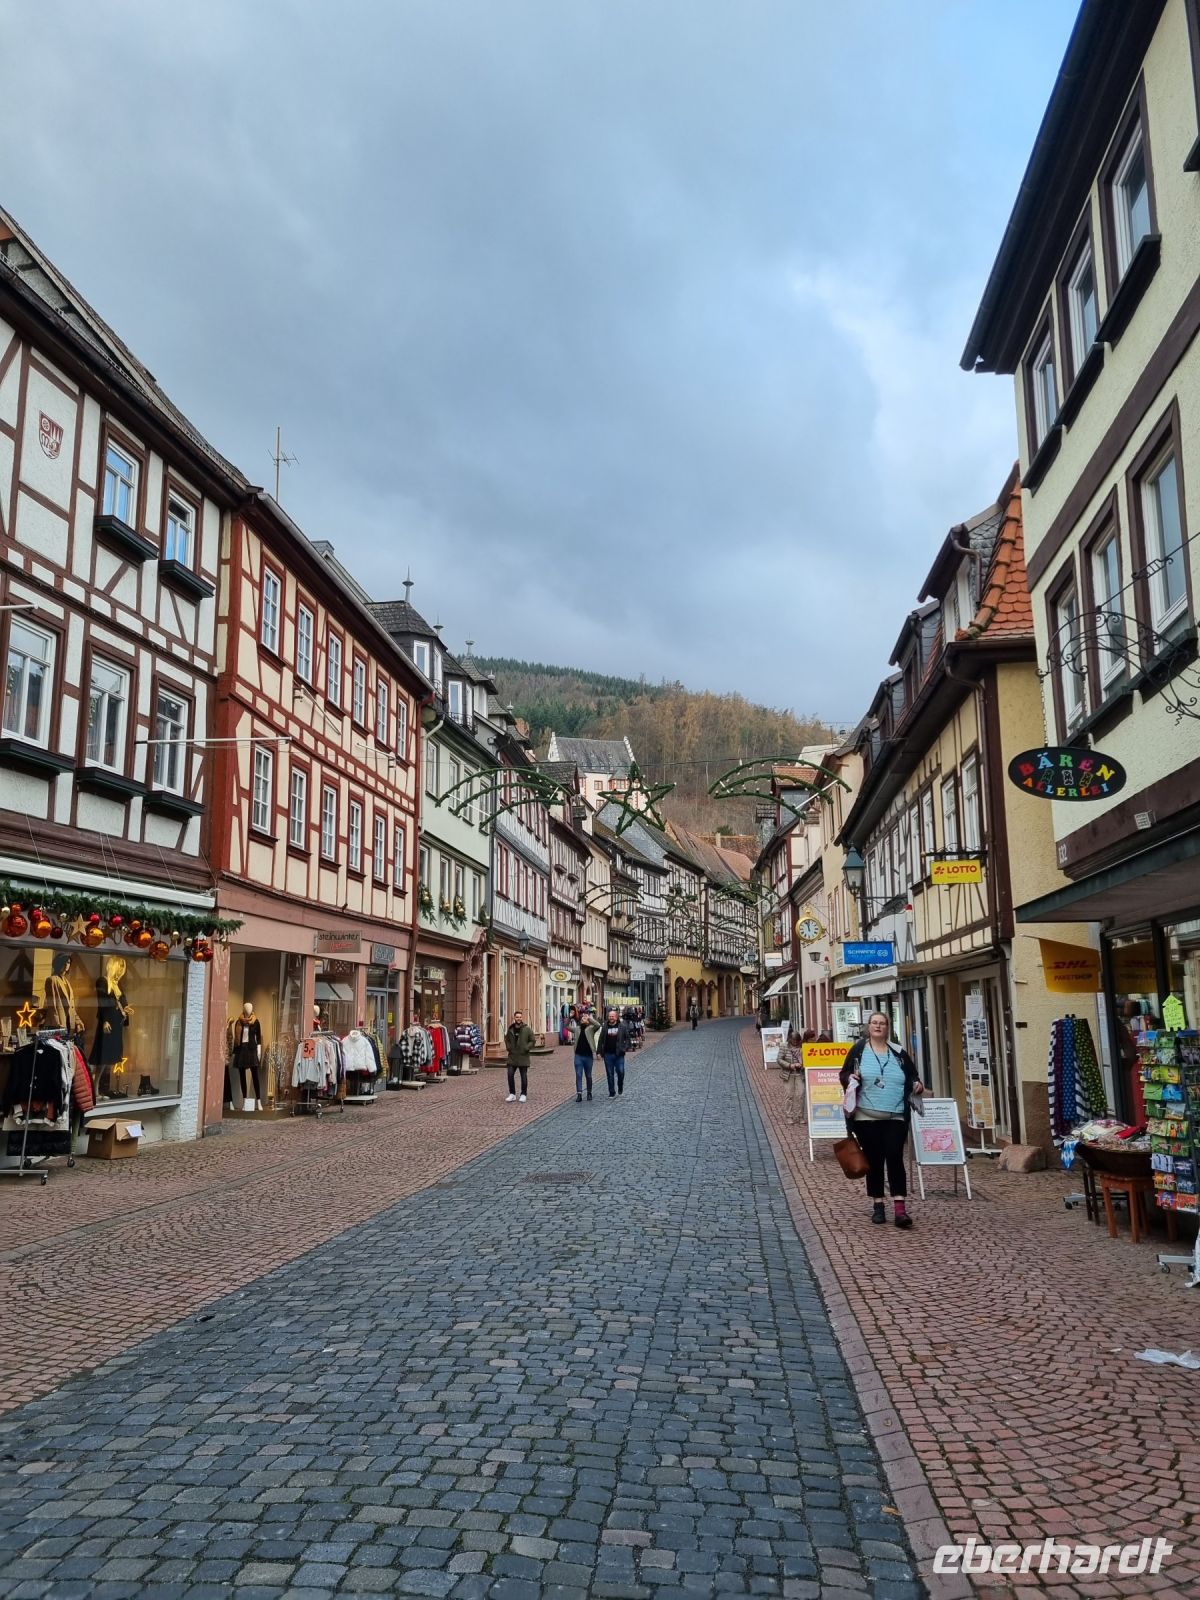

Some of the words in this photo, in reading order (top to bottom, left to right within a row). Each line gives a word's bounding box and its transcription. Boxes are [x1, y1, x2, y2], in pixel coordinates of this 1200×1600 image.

[1019, 752, 1115, 781] BÄREN
[1023, 777, 1109, 797] ALLERLEI
[1058, 843, 1068, 864] 132
[947, 865, 977, 874] LOTTO
[1053, 960, 1089, 969] DHL
[819, 1048, 848, 1056] LOTTO
